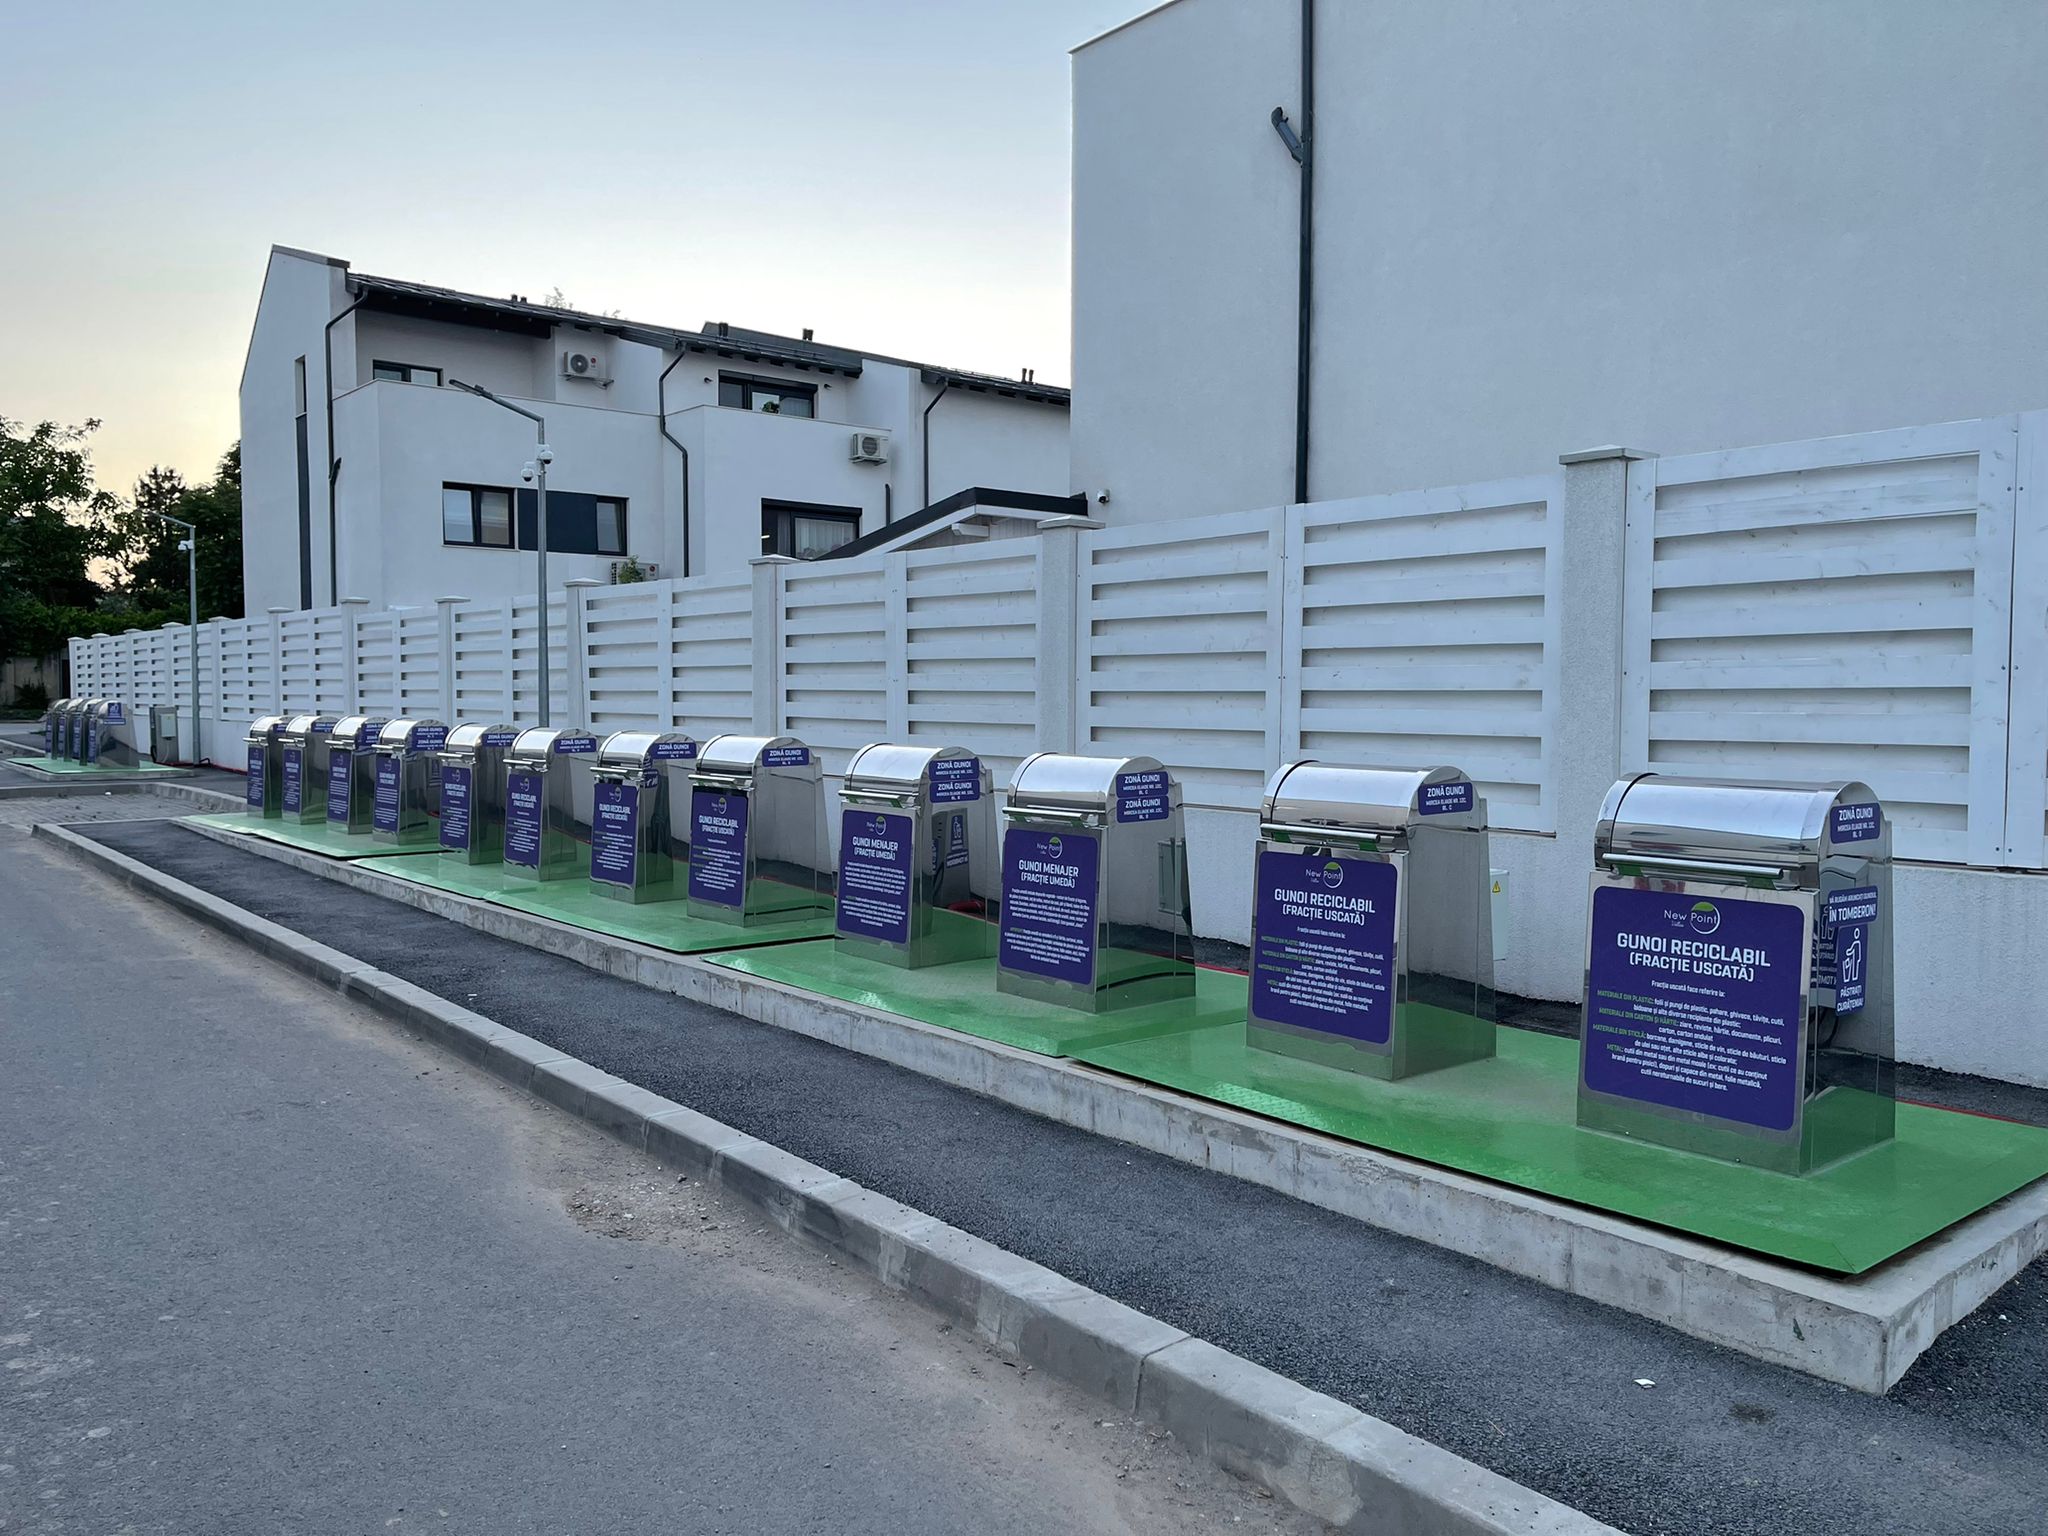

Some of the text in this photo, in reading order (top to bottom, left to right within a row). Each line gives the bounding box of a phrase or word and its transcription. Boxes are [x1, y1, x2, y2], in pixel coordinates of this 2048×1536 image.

[1125, 774, 1141, 783] ZONĂ
[1427, 785, 1464, 797] ZONĂ GUNOI
[1125, 799, 1160, 808] ZONĂ GUNOI
[1839, 806, 1873, 820] ZONĂ GUNOI
[1019, 860, 1079, 877] GUNOI MENAJER
[1274, 889, 1375, 913] GUNOI RECICLABIL
[1664, 910, 1717, 924] New Point
[1829, 904, 1876, 922] ÎN TOMBERON!
[1617, 933, 1771, 967] GUNOI RECICLABIL
[1630, 952, 1754, 982] (FRACȚIE USCATĂ)
